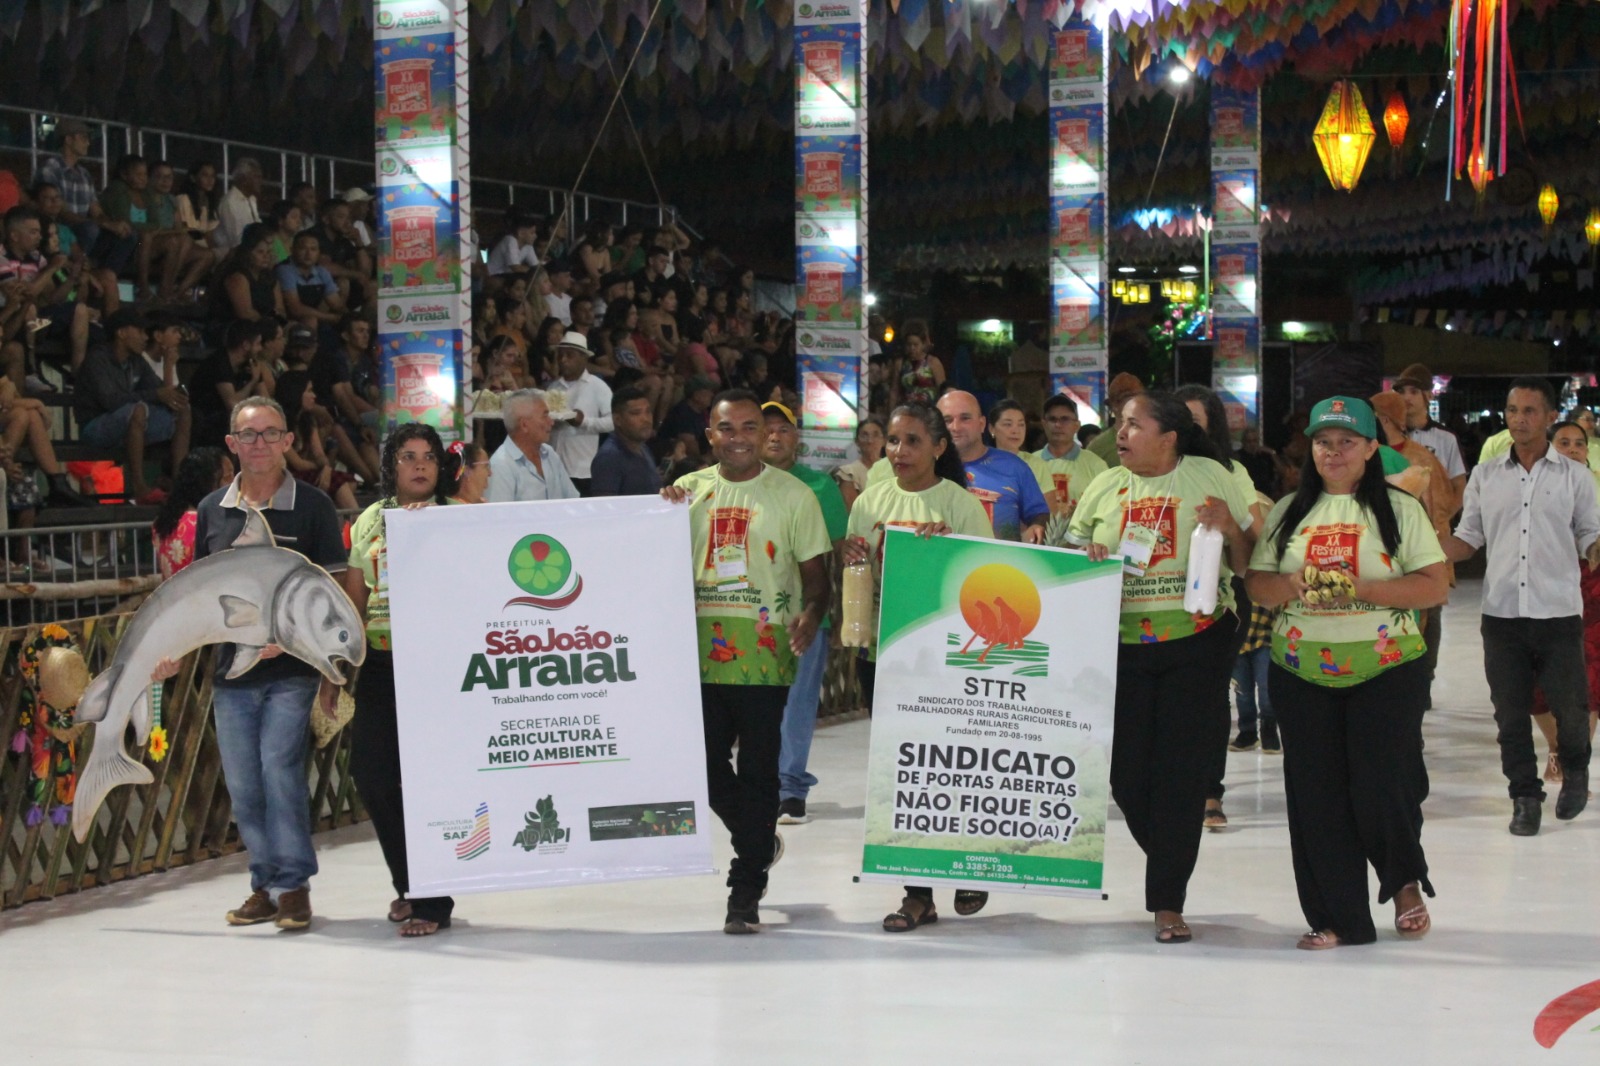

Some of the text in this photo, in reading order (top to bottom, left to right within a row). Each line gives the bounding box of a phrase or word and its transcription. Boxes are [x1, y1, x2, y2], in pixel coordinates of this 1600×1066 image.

[405, 310, 451, 323] Arraial
[1141, 507, 1156, 520] XX
[1326, 534, 1341, 546] XX
[1311, 545, 1354, 557] Festival
[729, 593, 740, 602] de
[743, 594, 762, 604] Vida
[1122, 586, 1156, 598] rojetos
[1158, 585, 1171, 594] de
[1354, 601, 1376, 611] Vida
[486, 619, 552, 629] PREFEITURA
[613, 633, 629, 644] do
[460, 648, 637, 692] Arraial
[963, 676, 1027, 701] STTR
[491, 689, 608, 705] Trabalhando com você!
[918, 696, 1072, 719] SINDICATO DOS TRABALHADORES E
[500, 714, 601, 732] SECRETARIA DE
[897, 704, 1092, 732] TRABALHADORAS RURAIS AGRICULTORES (A)
[967, 718, 1020, 731] FAMILIARES
[487, 727, 616, 748] AGRICULTURA E
[946, 726, 1043, 742] Fundado em 20-08-1995
[488, 743, 618, 765] MEIO AMBIENTE
[897, 742, 1076, 780] SINDICATO
[897, 770, 1077, 798] DE PORTAS ABERTAS
[896, 787, 952, 812] NÃO
[959, 794, 1032, 817] FIQUE
[427, 819, 473, 827] AGRICULTURA
[894, 813, 960, 834] FIQUE
[443, 831, 468, 841] SAF
[512, 827, 571, 847] ADAPI
[952, 861, 963, 870] 86
[966, 855, 1000, 864] CONTATO:
